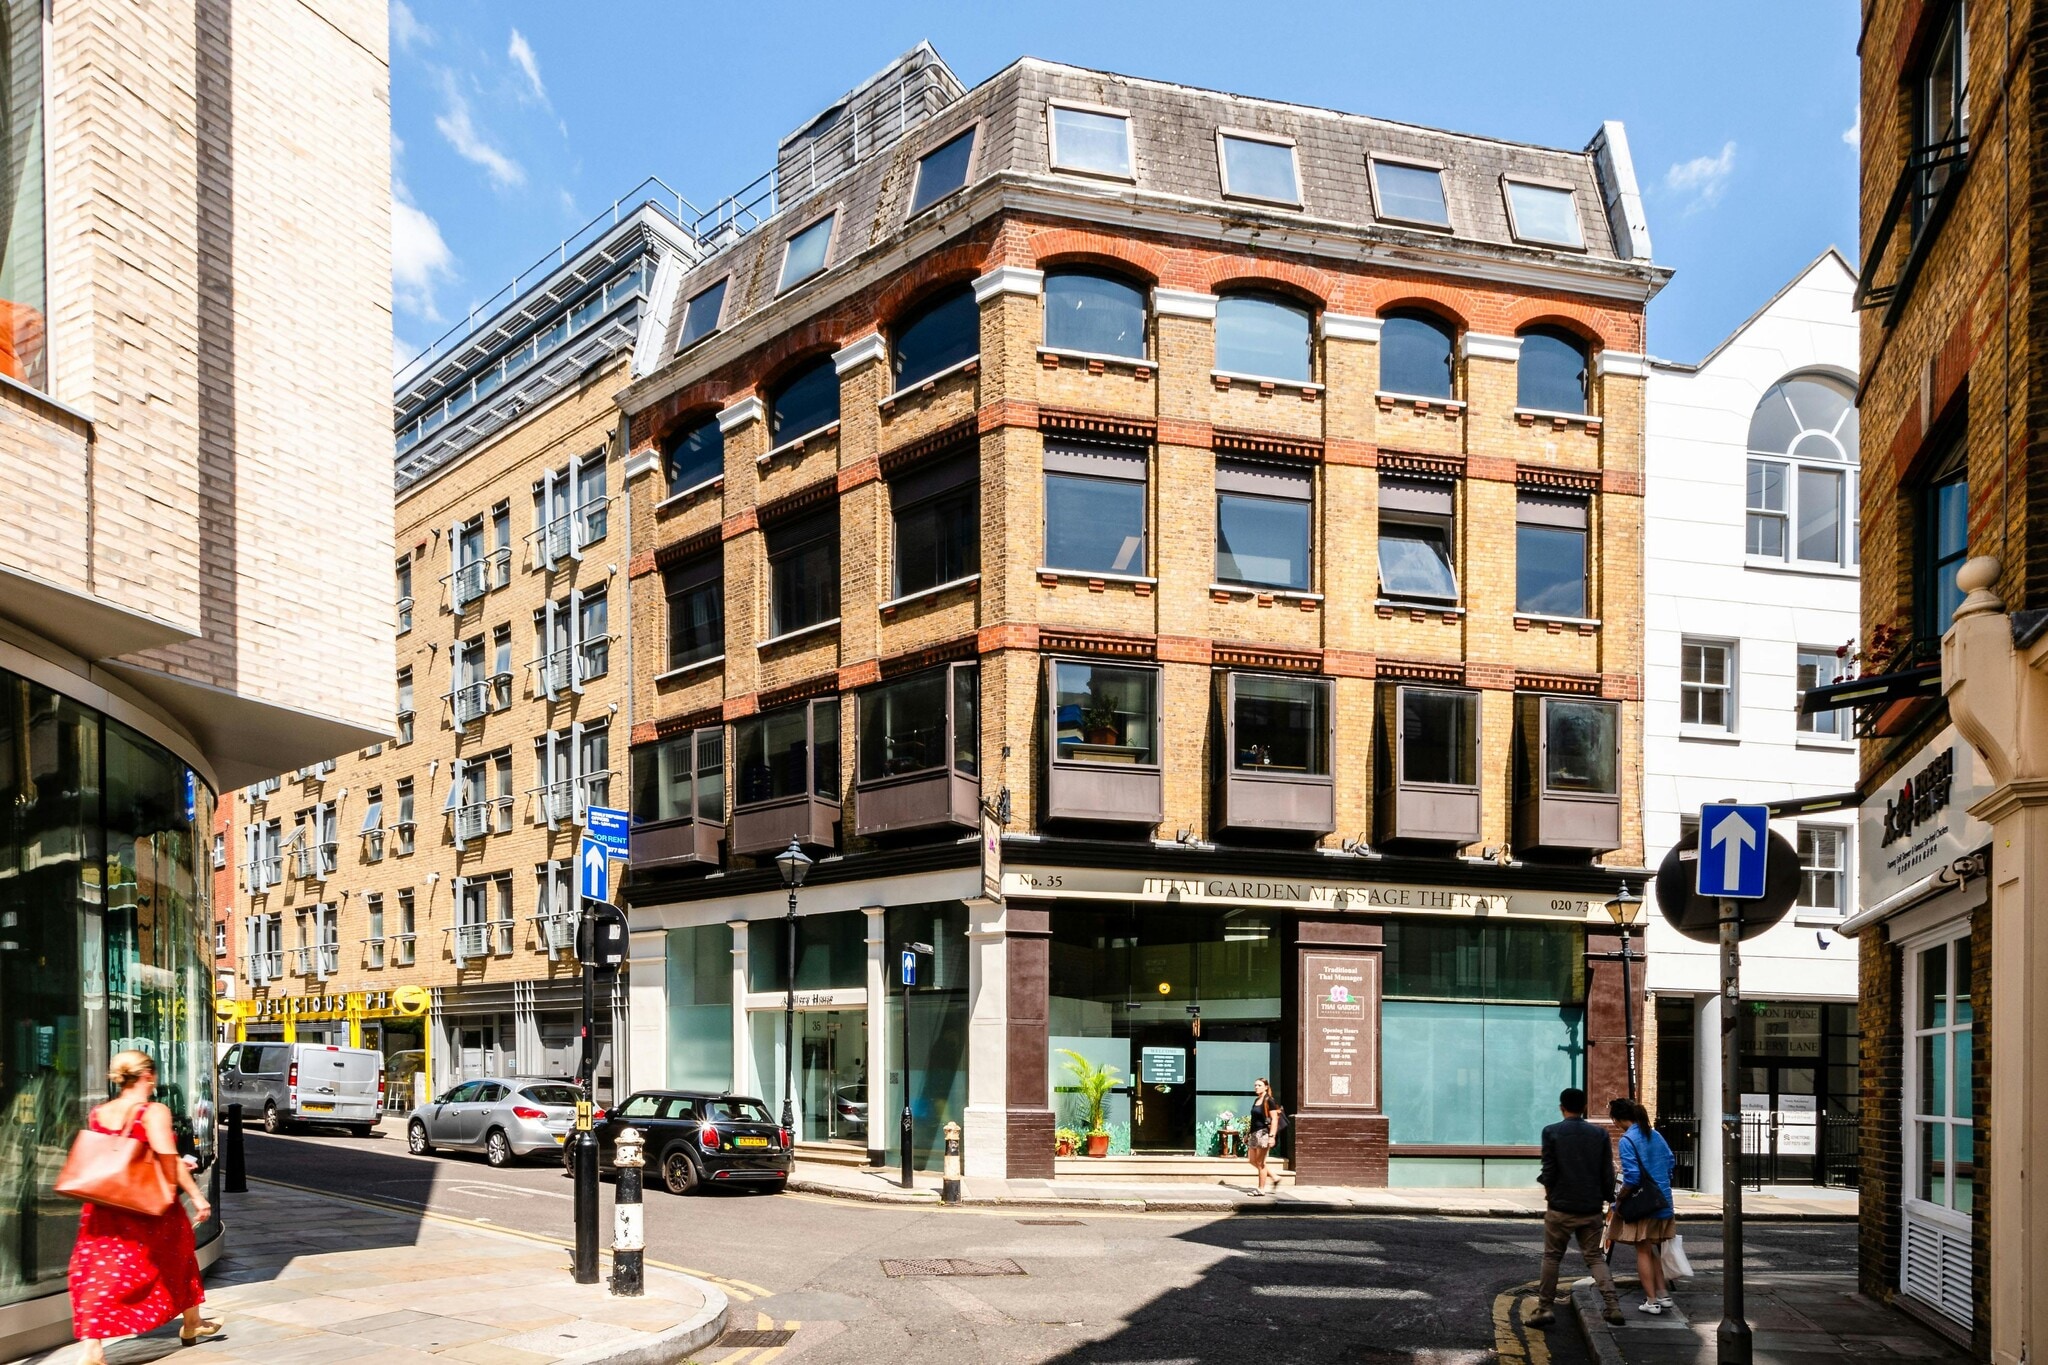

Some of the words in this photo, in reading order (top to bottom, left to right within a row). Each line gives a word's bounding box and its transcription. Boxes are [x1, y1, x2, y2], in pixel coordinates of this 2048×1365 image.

[1914, 747, 1953, 801] FRESH
[593, 834, 607, 842] FOR
[608, 836, 627, 844] RENT
[1020, 874, 1042, 886] No.
[1046, 876, 1063, 887] 35
[1145, 878, 1200, 895] THAI
[1208, 881, 1302, 900] GARDEN
[1310, 885, 1410, 906] MASSAGE
[1418, 891, 1513, 910] THERAPY
[1551, 900, 1572, 911] 020
[1323, 966, 1358, 974] Traditional
[1334, 974, 1363, 983] Massages
[256, 995, 344, 1016] DELICIOUS
[365, 991, 396, 1010] PH
[1783, 1008, 1818, 1019] HOUSE
[812, 1020, 821, 1031] 35
[1765, 1023, 1779, 1035] 37
[1789, 1042, 1818, 1052] LANE
